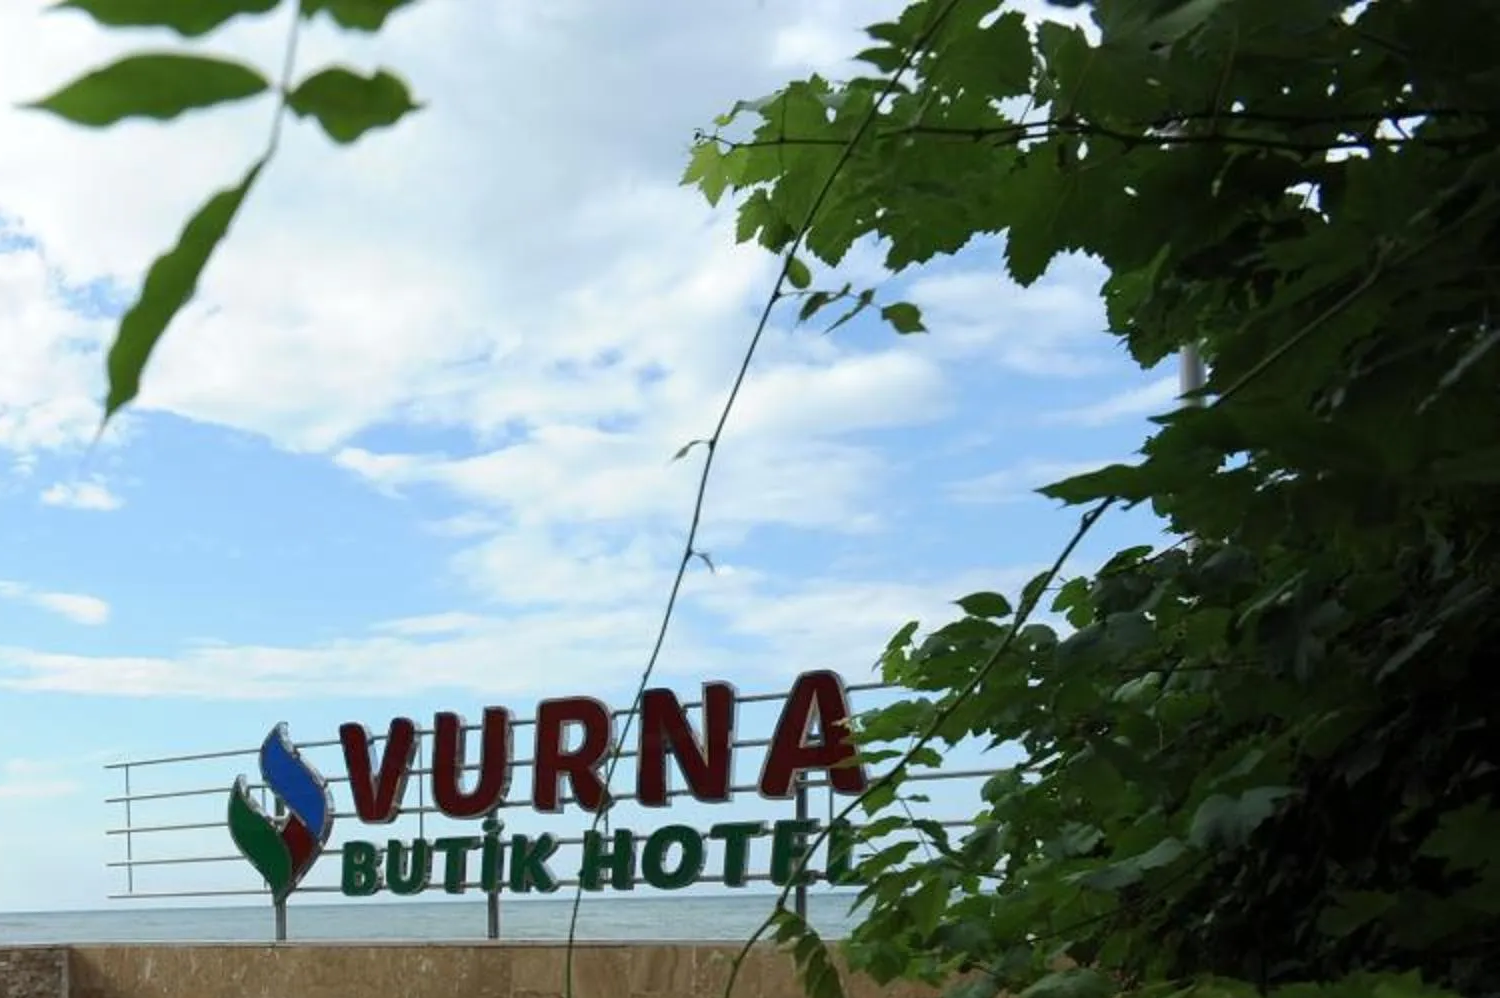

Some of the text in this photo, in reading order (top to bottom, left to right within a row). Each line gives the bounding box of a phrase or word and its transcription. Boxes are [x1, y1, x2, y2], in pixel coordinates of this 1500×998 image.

[339, 669, 868, 823] VURNA
[341, 817, 870, 896] BUTİK HOTEL
